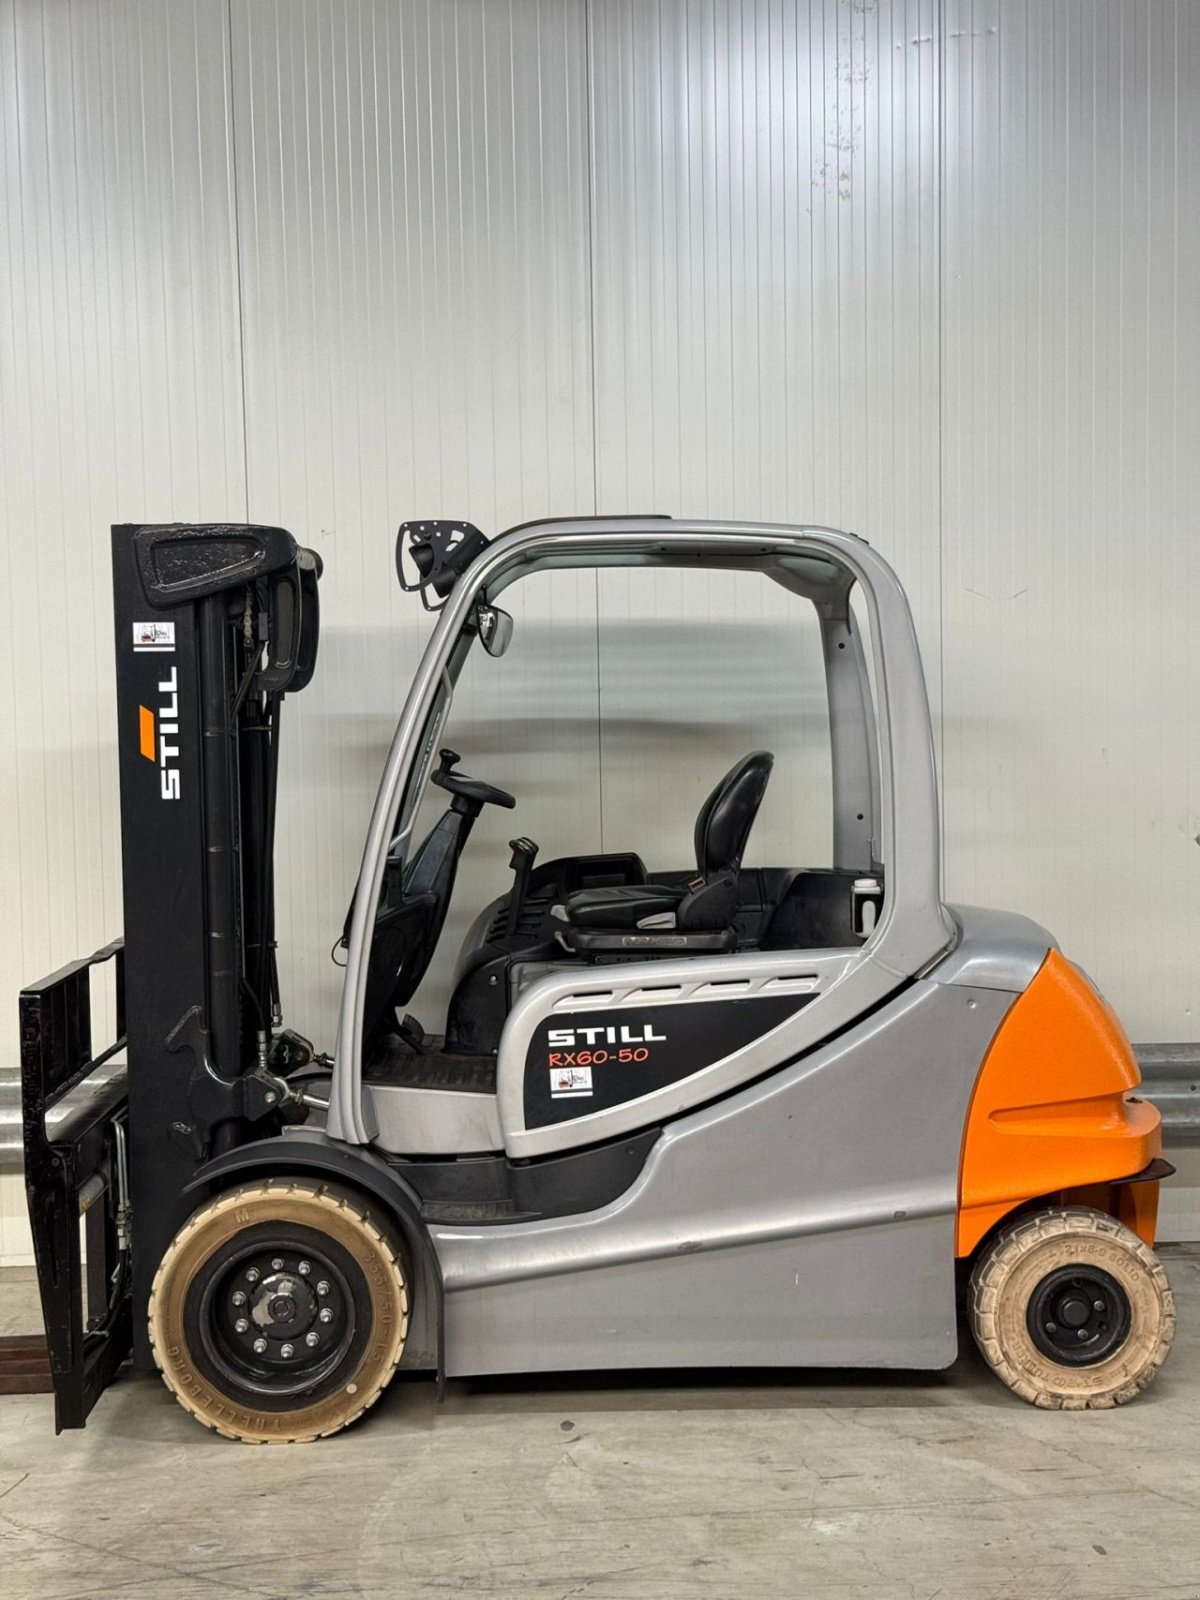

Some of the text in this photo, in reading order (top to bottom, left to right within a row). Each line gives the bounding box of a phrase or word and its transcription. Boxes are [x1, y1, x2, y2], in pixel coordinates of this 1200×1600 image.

[159, 666, 180, 799] STILL
[548, 1024, 667, 1047] STILL
[549, 1048, 649, 1067] RX60-50
